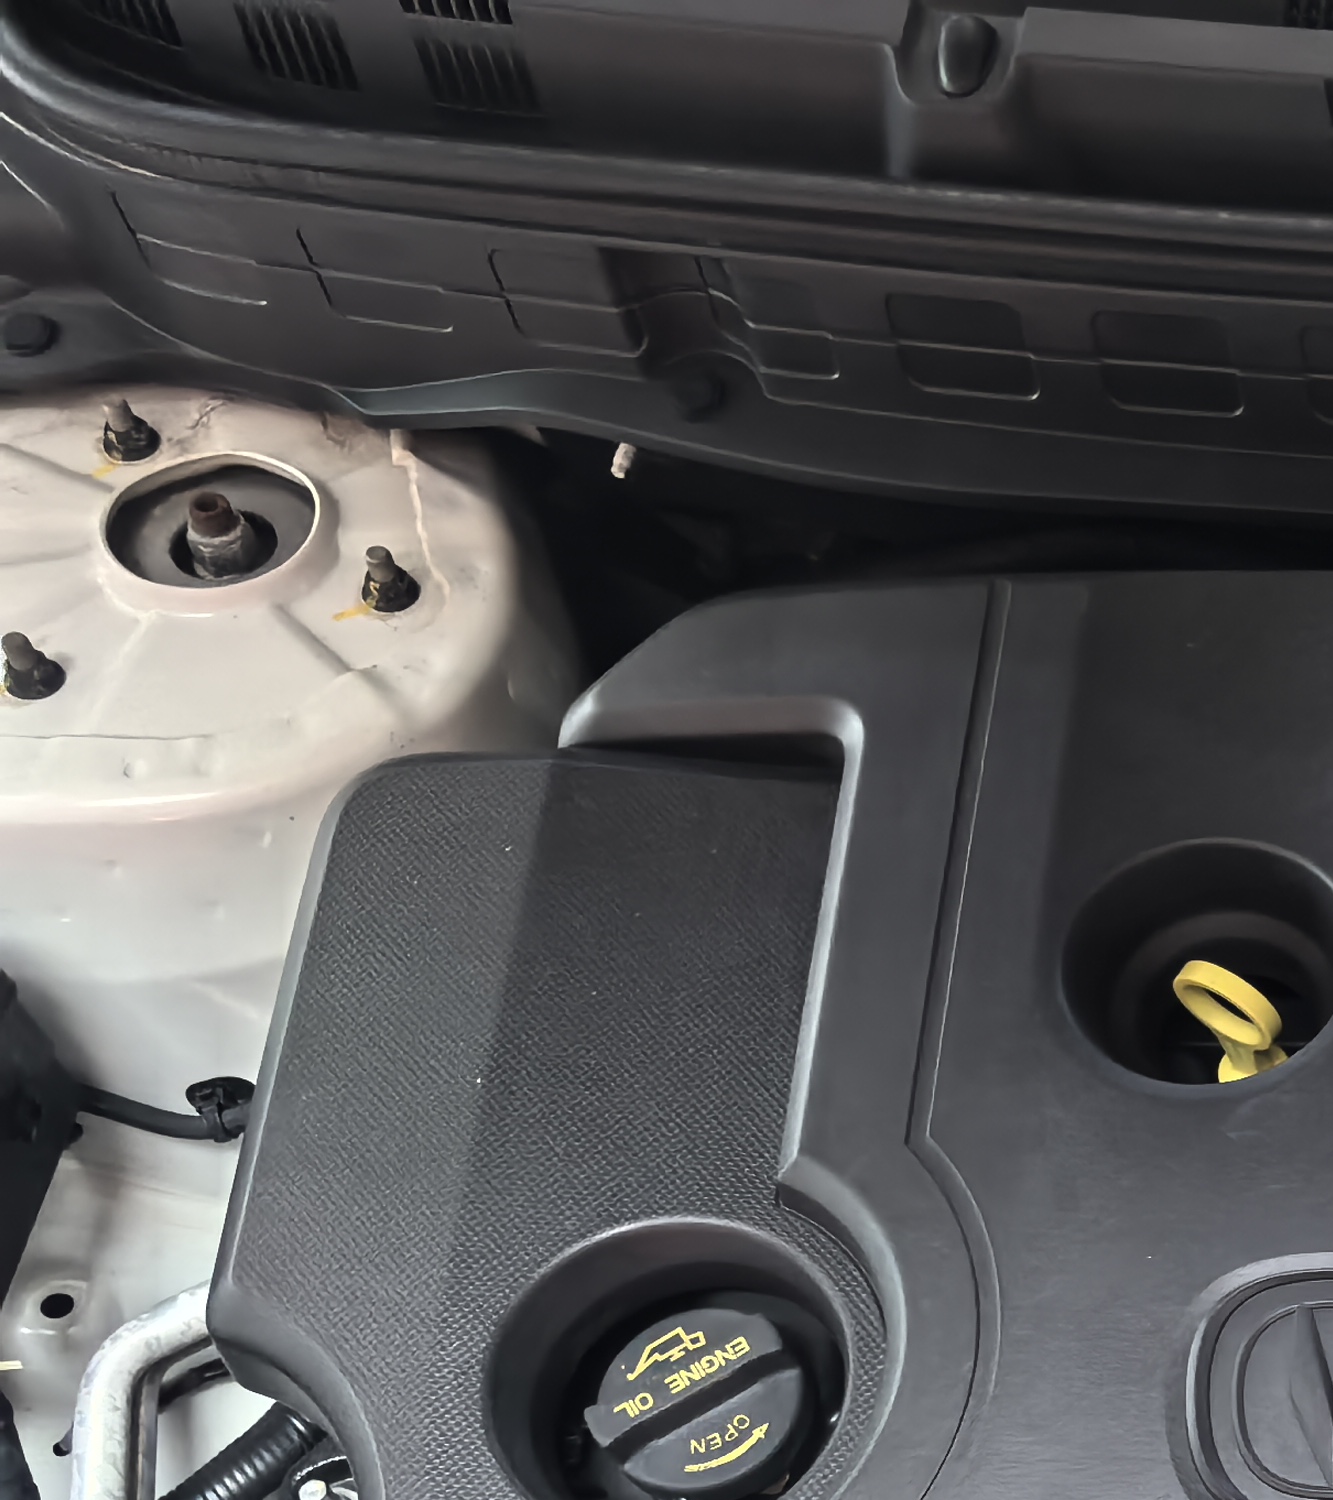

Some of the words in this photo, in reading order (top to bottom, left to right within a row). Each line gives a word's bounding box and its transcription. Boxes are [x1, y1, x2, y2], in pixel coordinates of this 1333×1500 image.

[664, 1336, 750, 1394] ENGINE
[613, 1392, 654, 1418] OIL
[690, 1414, 750, 1454] OPEN
